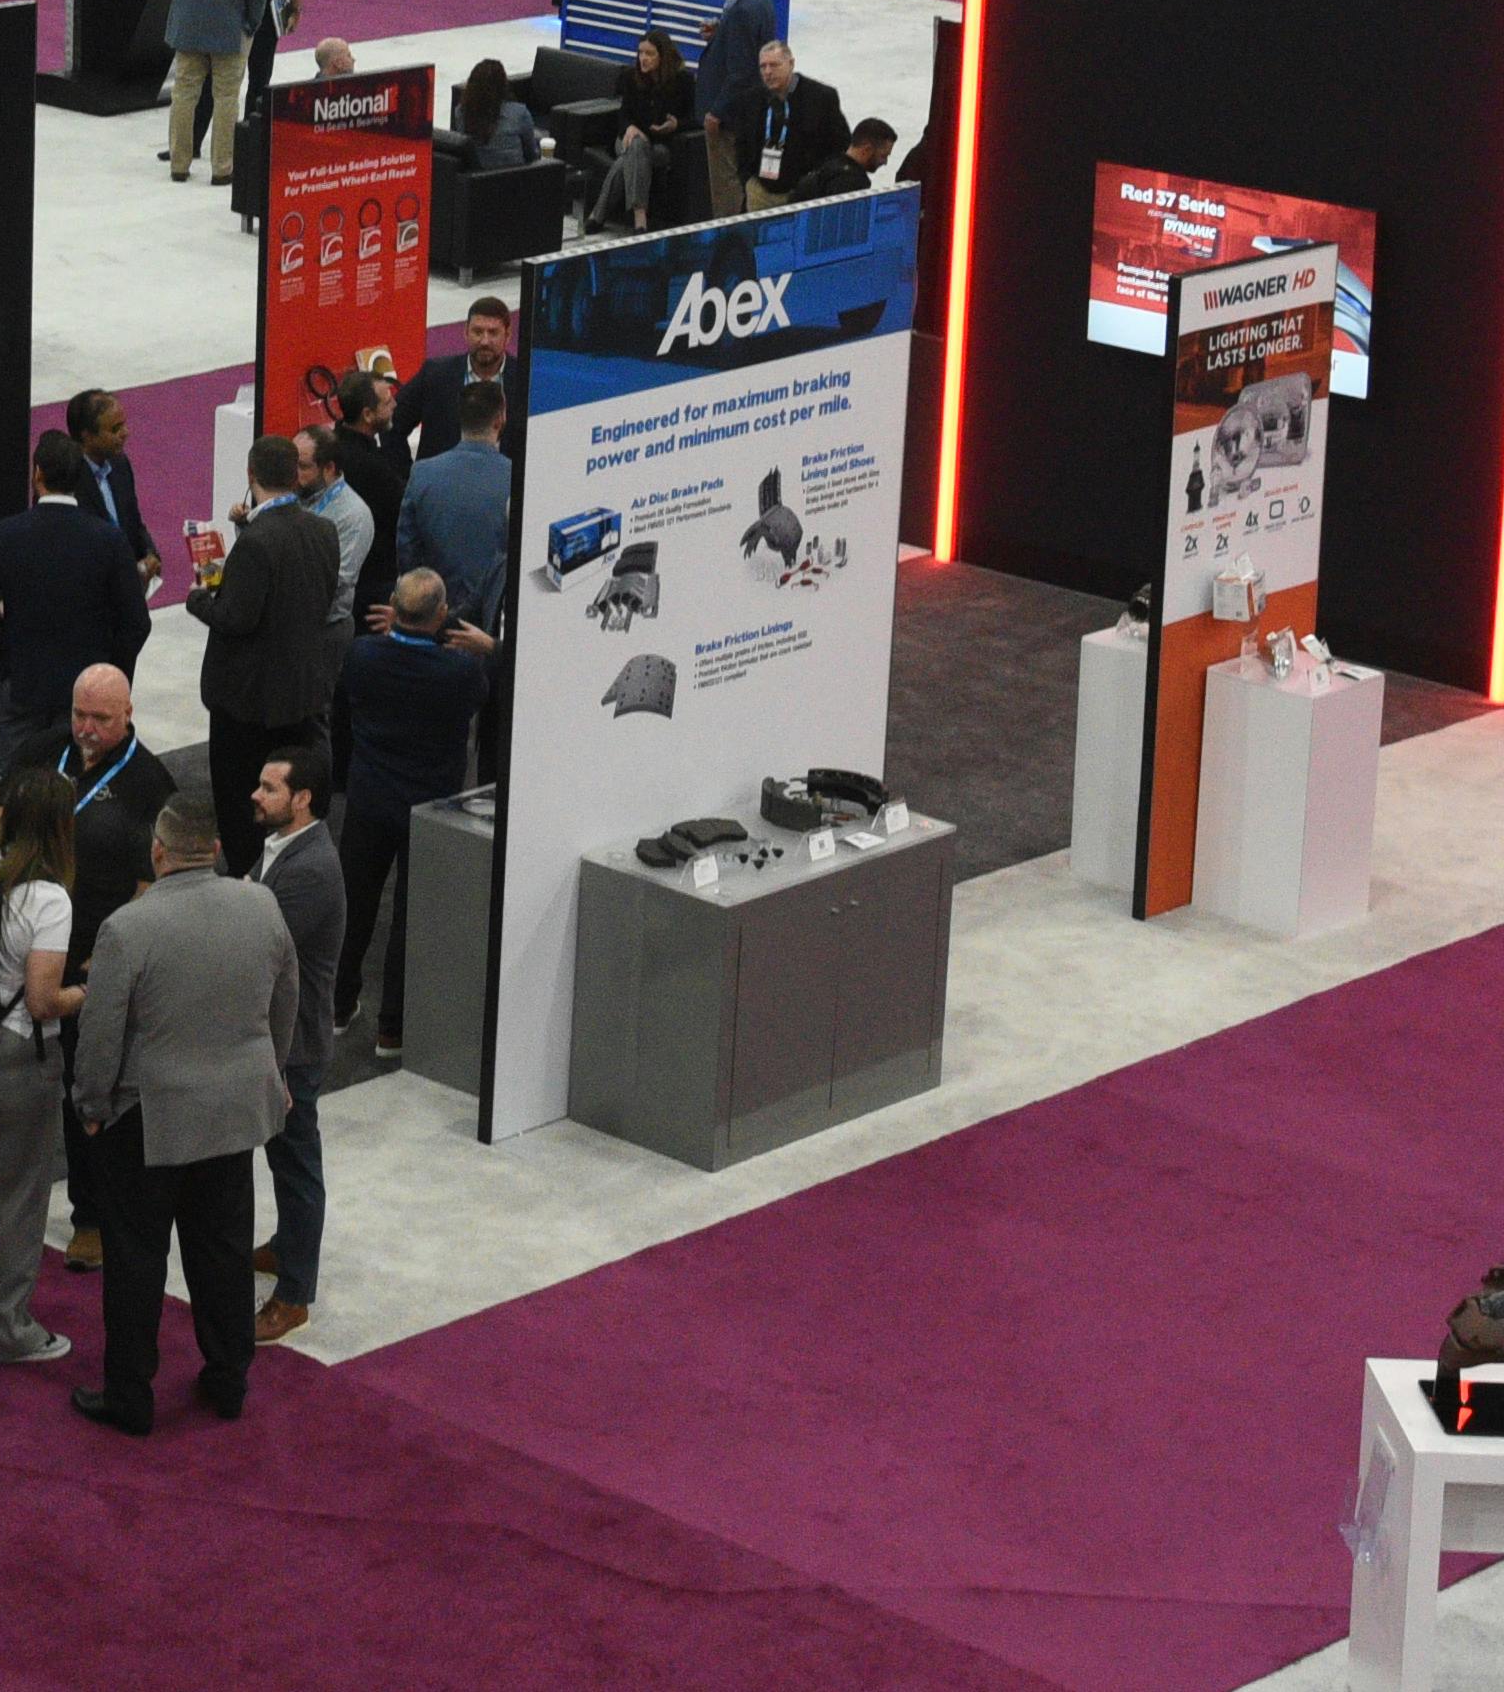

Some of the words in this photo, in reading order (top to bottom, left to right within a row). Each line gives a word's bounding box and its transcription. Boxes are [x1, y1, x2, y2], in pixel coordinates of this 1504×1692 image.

[314, 88, 390, 122] National
[284, 184, 300, 197] For
[301, 179, 340, 194] Premium
[388, 166, 418, 181] Repair
[288, 169, 308, 183] Your
[310, 163, 348, 179] Full-Line
[349, 158, 380, 175] Sealing
[380, 153, 416, 167] Solution
[1121, 182, 1154, 204] Red
[1155, 189, 1176, 207] 37
[1178, 194, 1226, 218] Series
[1163, 219, 1217, 240] DYNAMIC
[1117, 262, 1154, 279] Pumping
[1218, 274, 1289, 307] WAGNER
[1292, 267, 1317, 291] HD
[1208, 324, 1268, 352] LIGHTING
[1271, 314, 1305, 335] THAT
[1207, 350, 1246, 371] LASTS
[1248, 335, 1304, 359] LONGER.
[591, 407, 680, 445] Engineered
[683, 403, 708, 423] for
[712, 384, 789, 416] maximum
[793, 370, 851, 398] braking
[586, 448, 640, 475] power
[644, 436, 675, 459] and
[678, 419, 750, 449] minimum
[753, 410, 787, 433] cost
[789, 405, 816, 426] per
[818, 393, 852, 416] mile.
[801, 451, 828, 467] Brake
[830, 442, 864, 459] Friction
[801, 466, 829, 482] Lining
[830, 461, 848, 474] and
[849, 455, 875, 470] Shoes
[631, 494, 647, 510] Air
[648, 489, 669, 506] Disc
[671, 482, 699, 502] Brake
[701, 476, 724, 495] Pads
[695, 641, 722, 656] Brake
[724, 629, 759, 648] Friction
[761, 619, 793, 636] Linings
